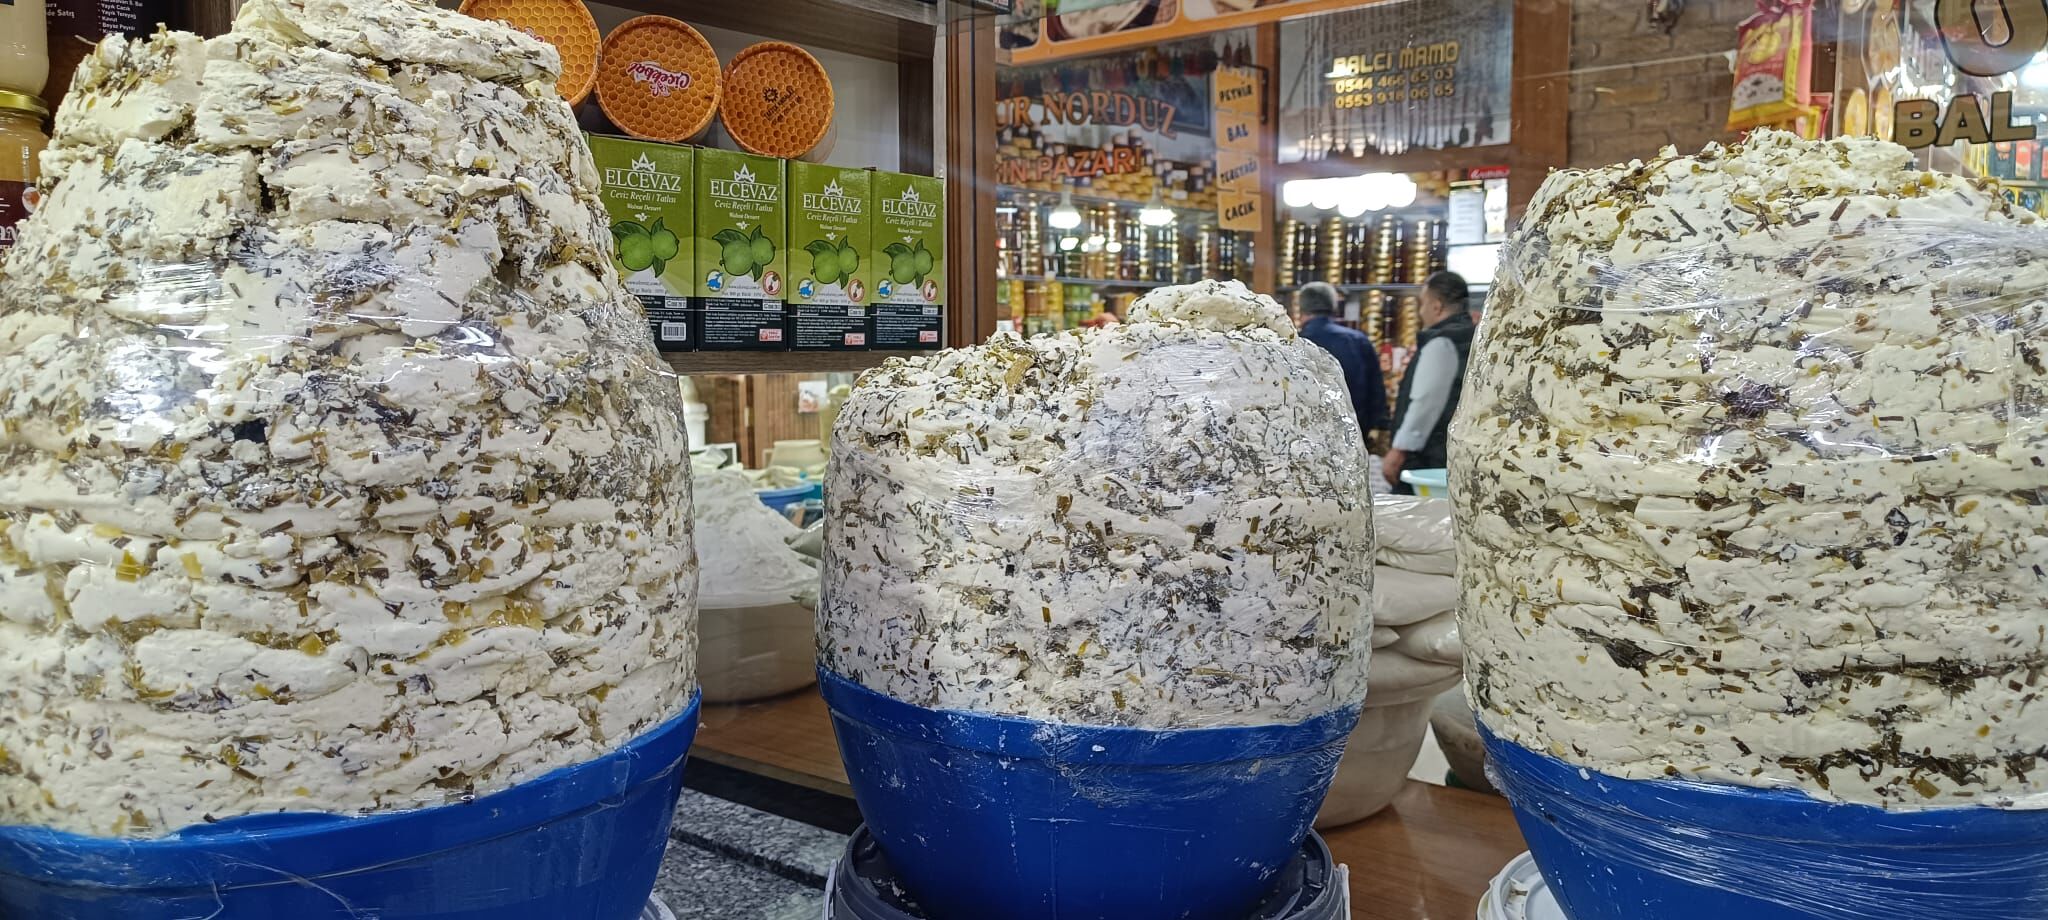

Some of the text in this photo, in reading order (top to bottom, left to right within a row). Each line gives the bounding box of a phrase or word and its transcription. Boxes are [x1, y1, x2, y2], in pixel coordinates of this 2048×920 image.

[1400, 41, 1459, 69] MAMO
[1335, 77, 1373, 94] 0544
[1335, 92, 1373, 109] 0553
[1042, 91, 1177, 140] NORDUZ
[1893, 91, 2037, 149] BAL
[1226, 123, 1249, 143] BAL
[1037, 146, 1141, 181] PAZARI
[605, 169, 681, 191] ELCEVAZ
[710, 180, 778, 201] ELCEVAZ
[803, 194, 862, 213] ELCEVAZ
[882, 199, 937, 217] ELCEVAZ
[1224, 200, 1256, 221] CACIK
